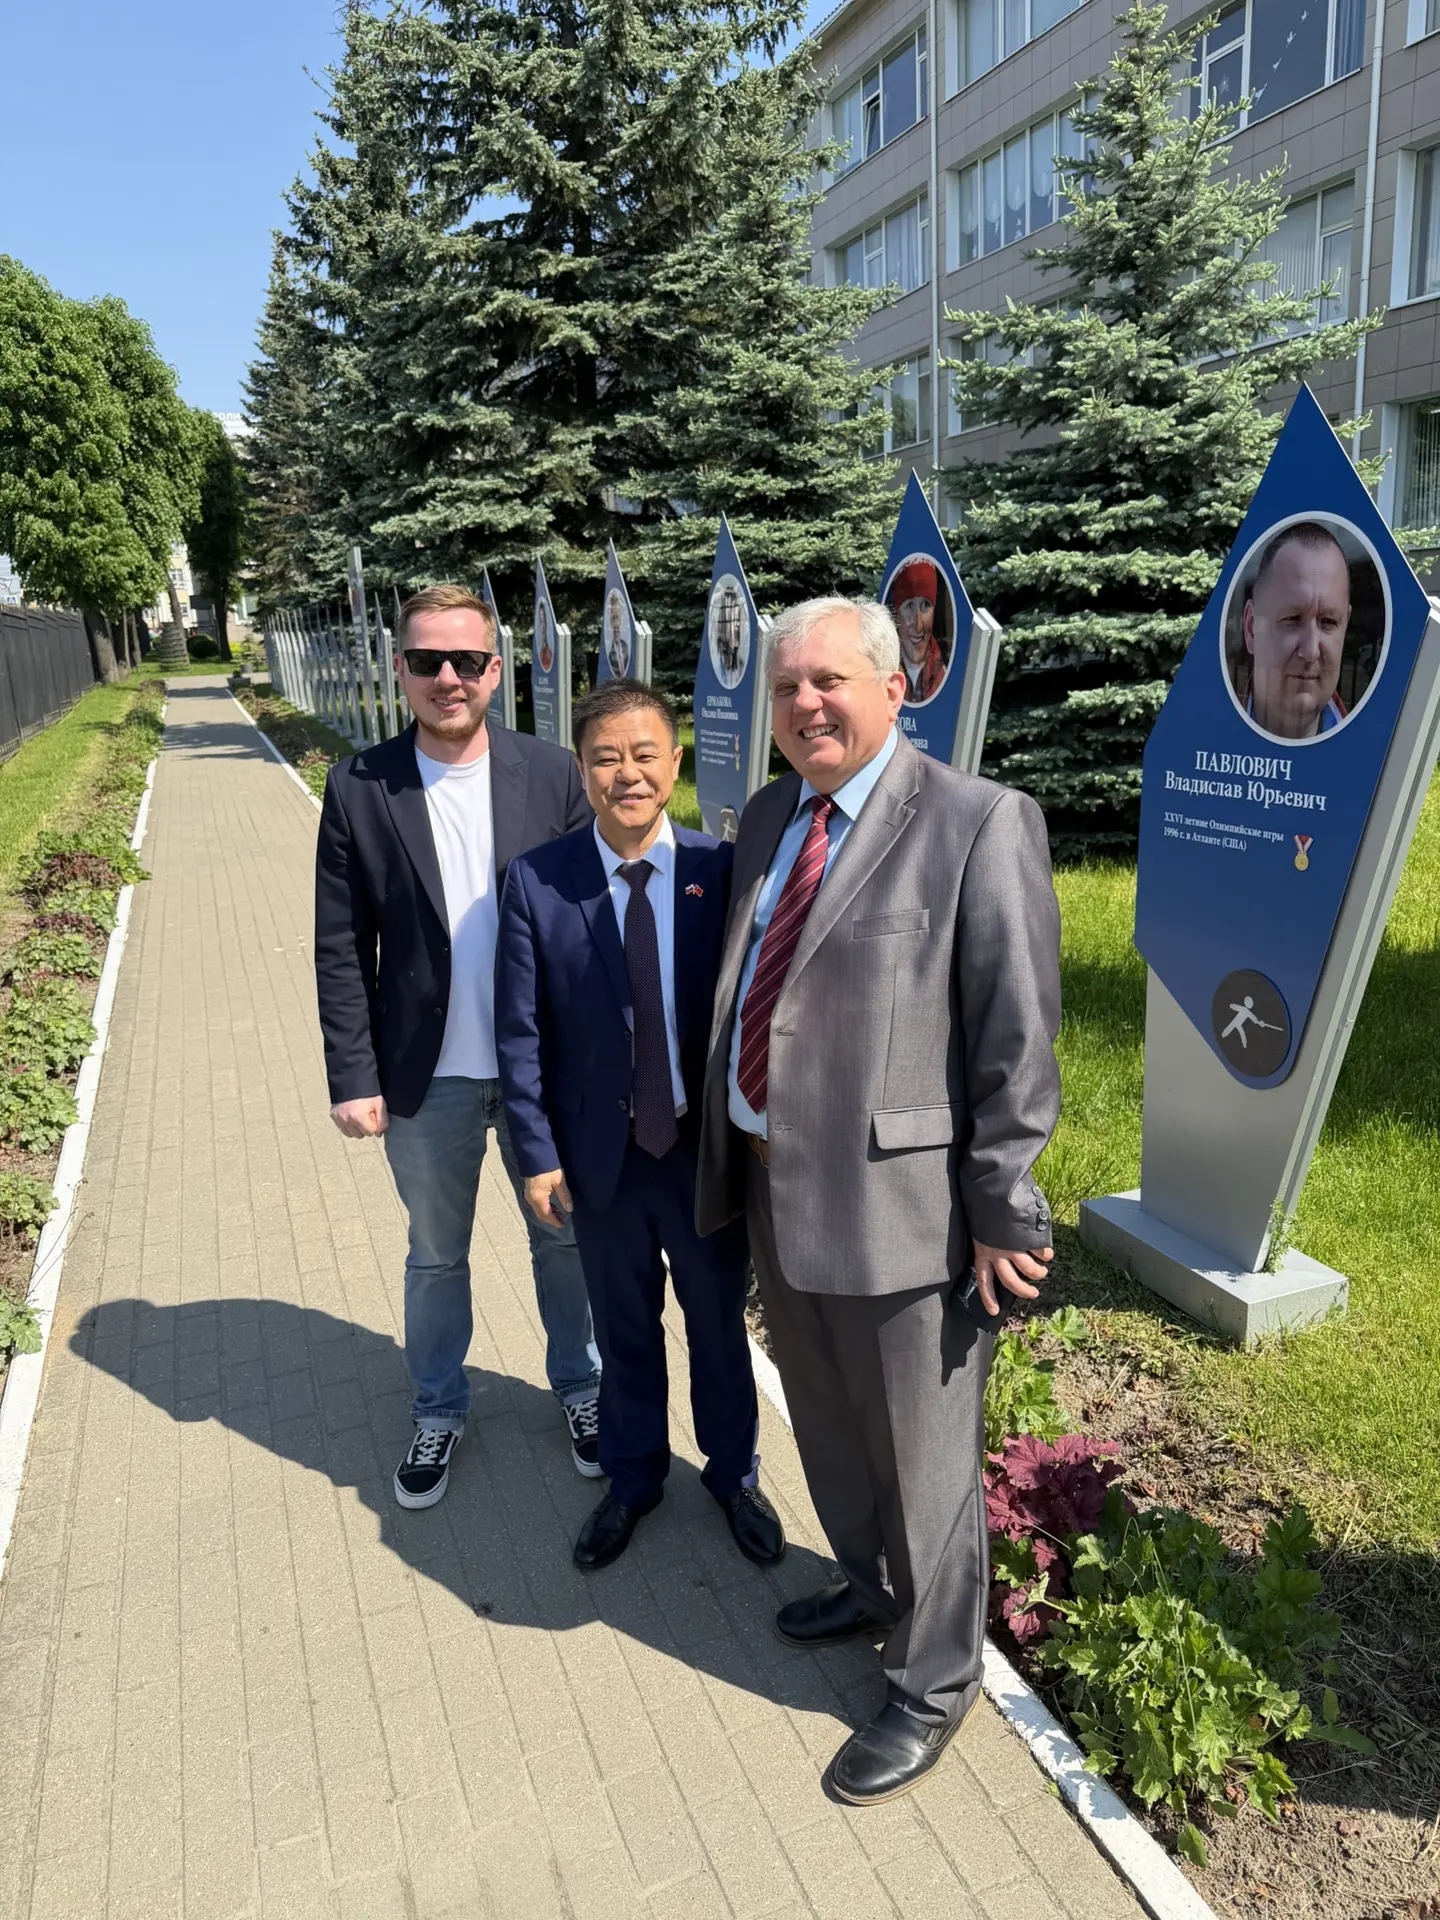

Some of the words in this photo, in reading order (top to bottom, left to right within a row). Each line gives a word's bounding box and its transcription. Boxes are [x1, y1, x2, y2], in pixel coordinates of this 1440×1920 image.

[1194, 750, 1293, 781] ПАВЛОВИЧ
[1164, 770, 1243, 799] Владислав
[1246, 780, 1327, 811] Юрьевич
[1163, 826, 1179, 838] 1996
[1191, 831, 1221, 846] Атланте
[1221, 836, 1247, 852] (США)
[1164, 811, 1183, 825] XXVI
[1184, 817, 1209, 830] летние
[1209, 819, 1262, 838] Олимпийские
[1263, 831, 1284, 843] игры
